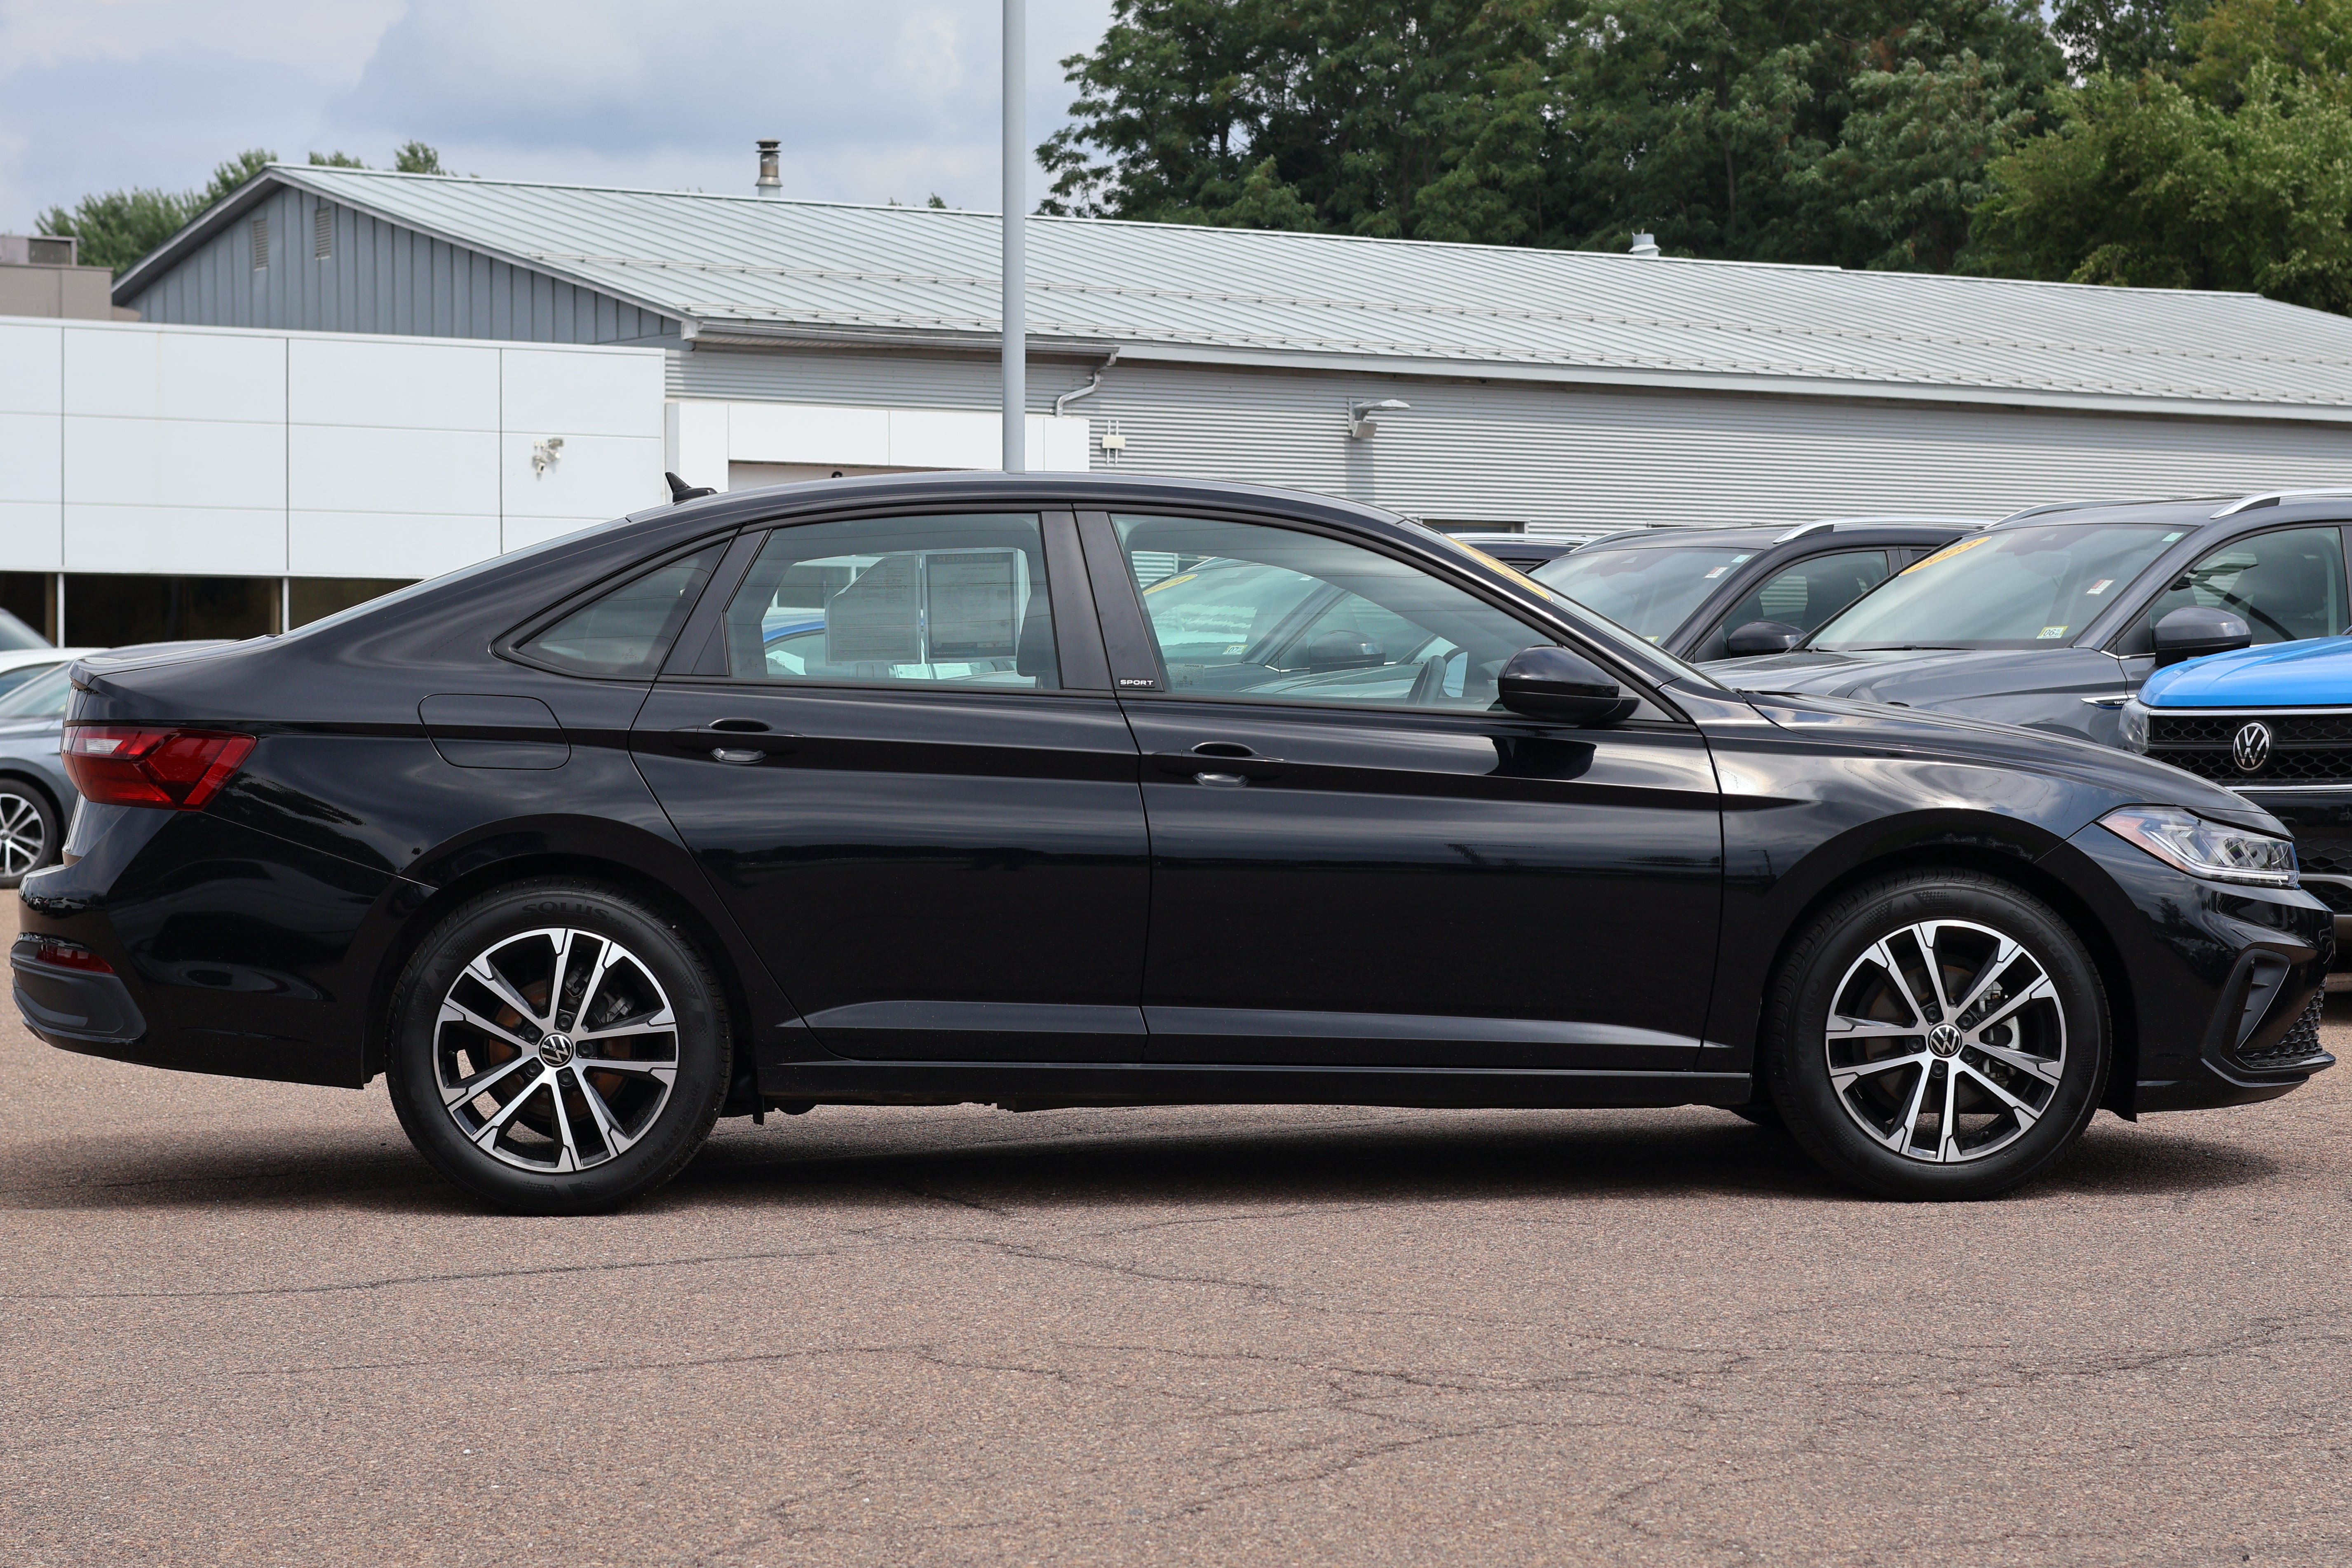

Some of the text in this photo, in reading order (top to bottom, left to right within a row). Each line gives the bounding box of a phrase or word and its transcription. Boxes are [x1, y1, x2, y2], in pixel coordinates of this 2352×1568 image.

[2233, 723, 2269, 770] VW
[522, 901, 610, 922] SOLUS
[2006, 907, 2075, 973] SOLUS
[541, 1035, 572, 1066] VW
[1930, 1025, 1960, 1056] VW
